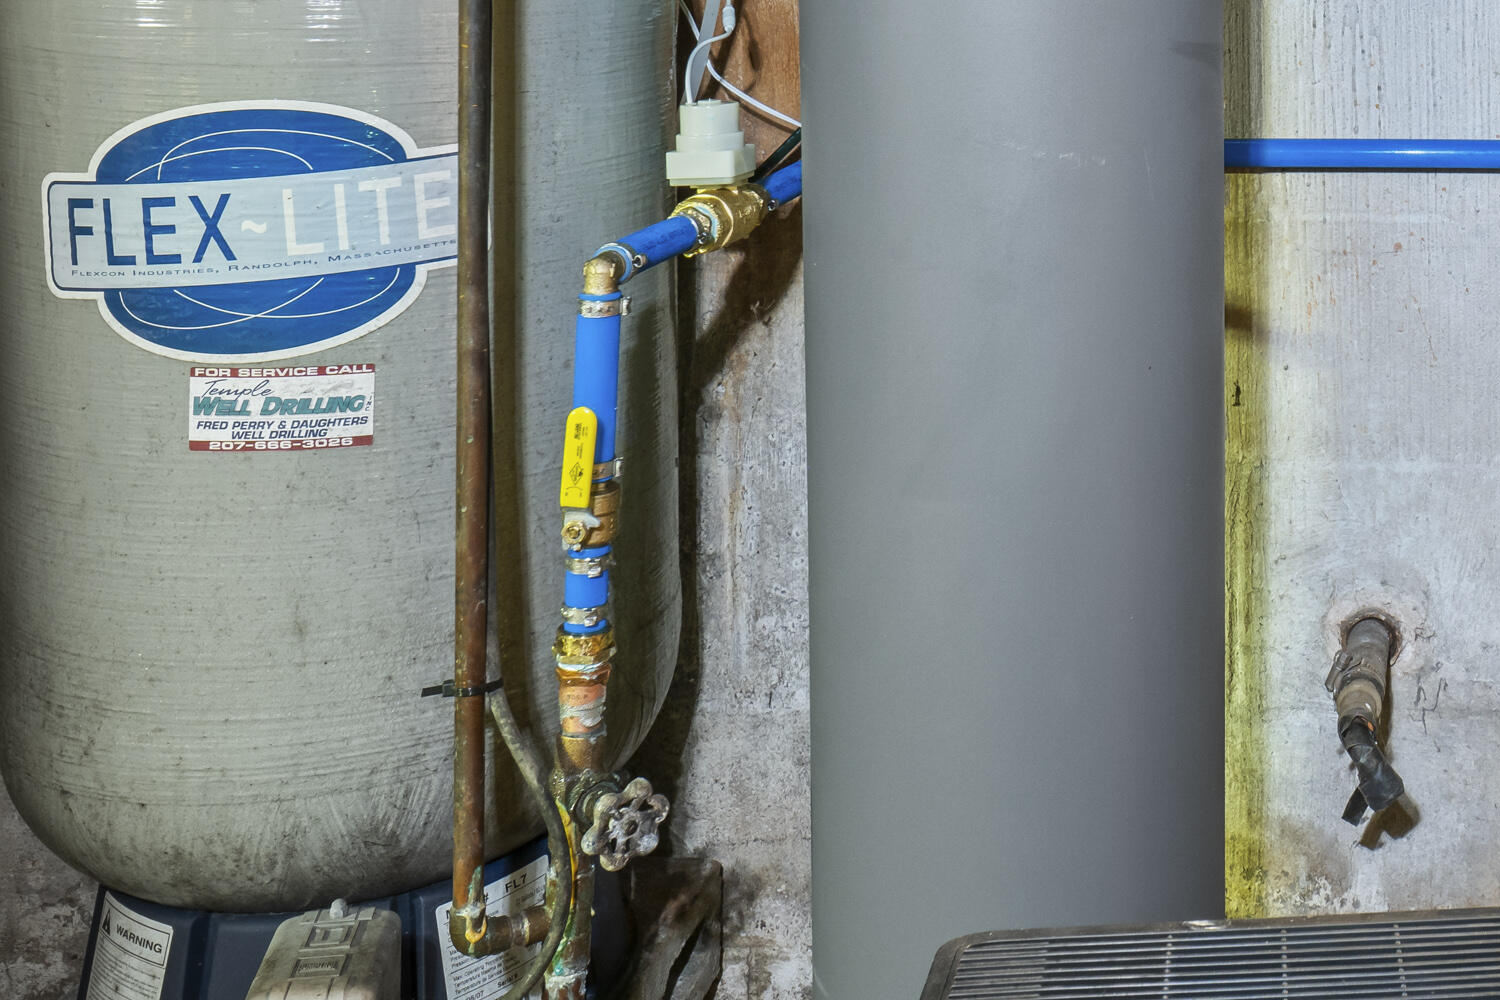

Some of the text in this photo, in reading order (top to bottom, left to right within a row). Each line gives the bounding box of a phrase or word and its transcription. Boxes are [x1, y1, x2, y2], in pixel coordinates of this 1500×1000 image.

[71, 269, 126, 277] FLEXCON
[194, 364, 372, 376] FOR SERVICE CALL
[202, 379, 274, 401] Temple
[193, 396, 252, 415] WELL
[260, 395, 365, 415] DRILLING
[196, 416, 368, 429] FRED PERRY & DAUGHTERS
[231, 429, 327, 439] WELL DRILLING
[209, 438, 352, 450] 207-666-3026
[505, 873, 527, 892] FL7
[116, 924, 162, 954] WARNING
